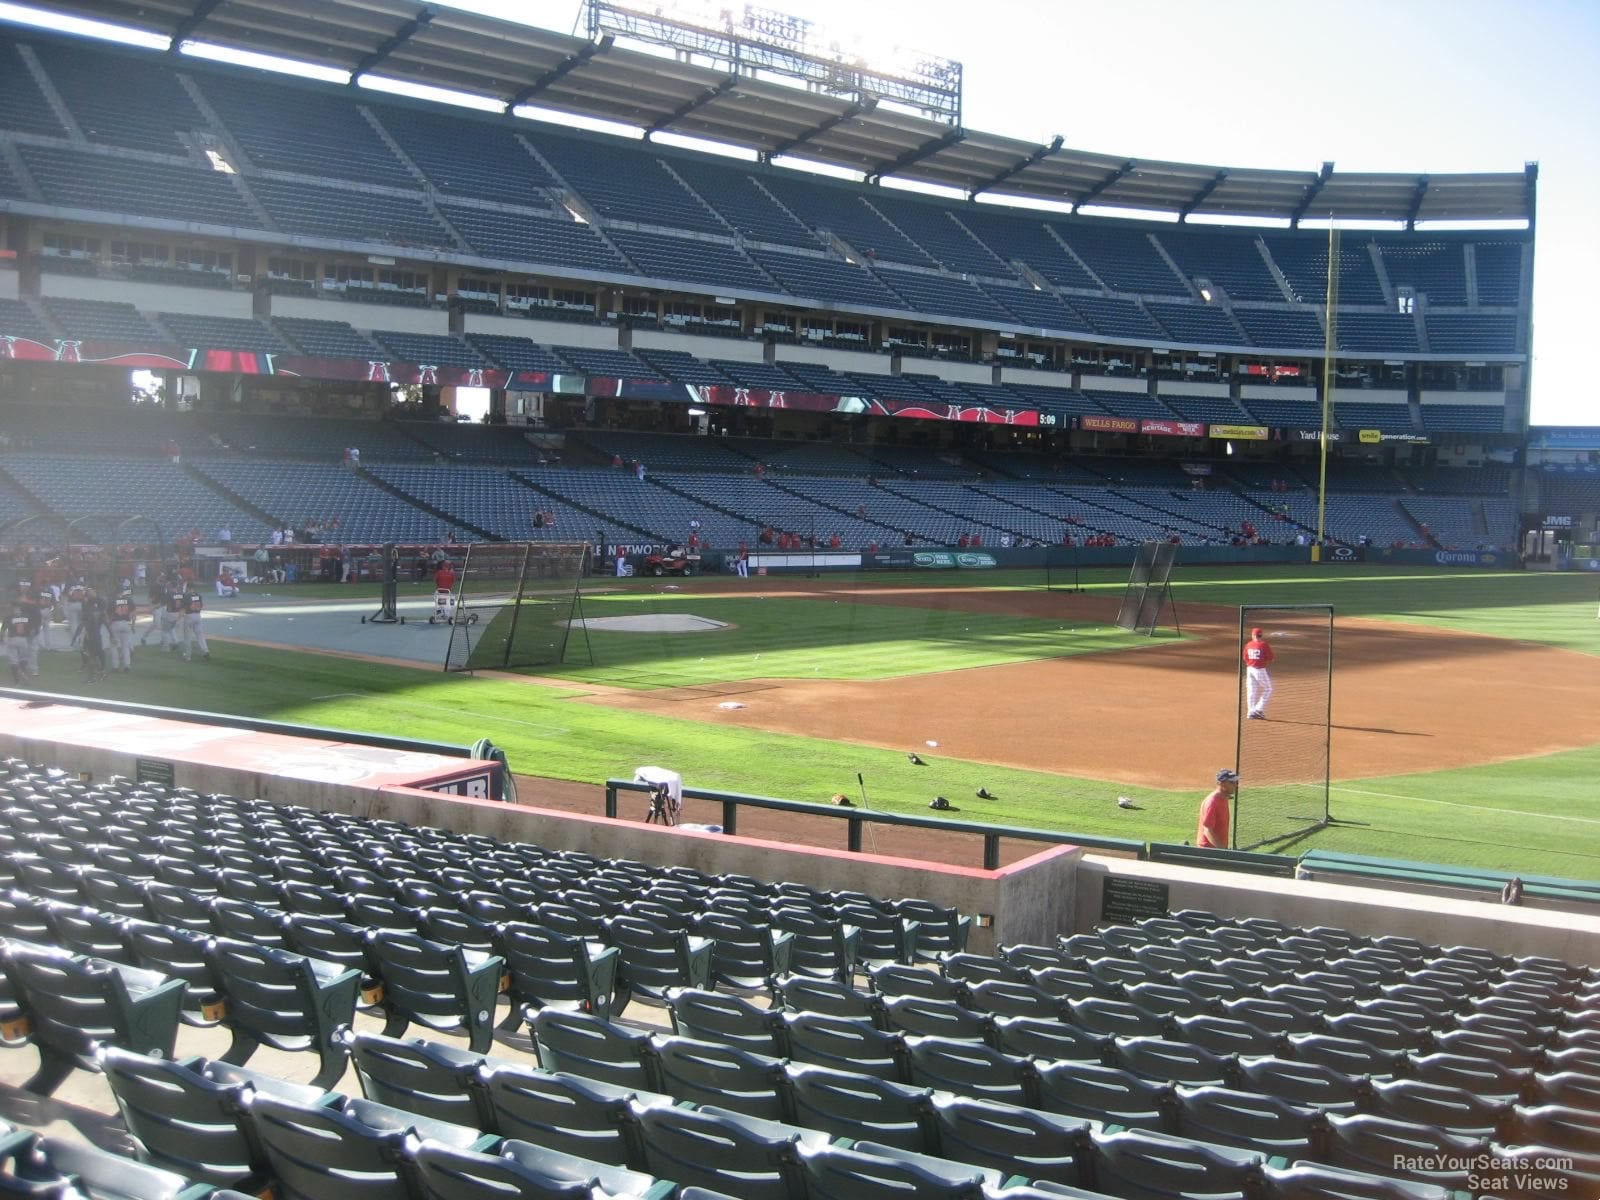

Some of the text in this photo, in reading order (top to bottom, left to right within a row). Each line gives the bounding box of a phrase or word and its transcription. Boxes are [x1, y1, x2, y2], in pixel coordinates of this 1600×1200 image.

[1039, 414, 1056, 425] 5:09
[1085, 418, 1136, 430] WELLS FARGO
[1142, 424, 1172, 433] HERITAGE
[1299, 430, 1316, 440] Yard
[1361, 432, 1379, 440] smile
[1542, 515, 1572, 526] JMG
[1435, 550, 1476, 563] Corona
